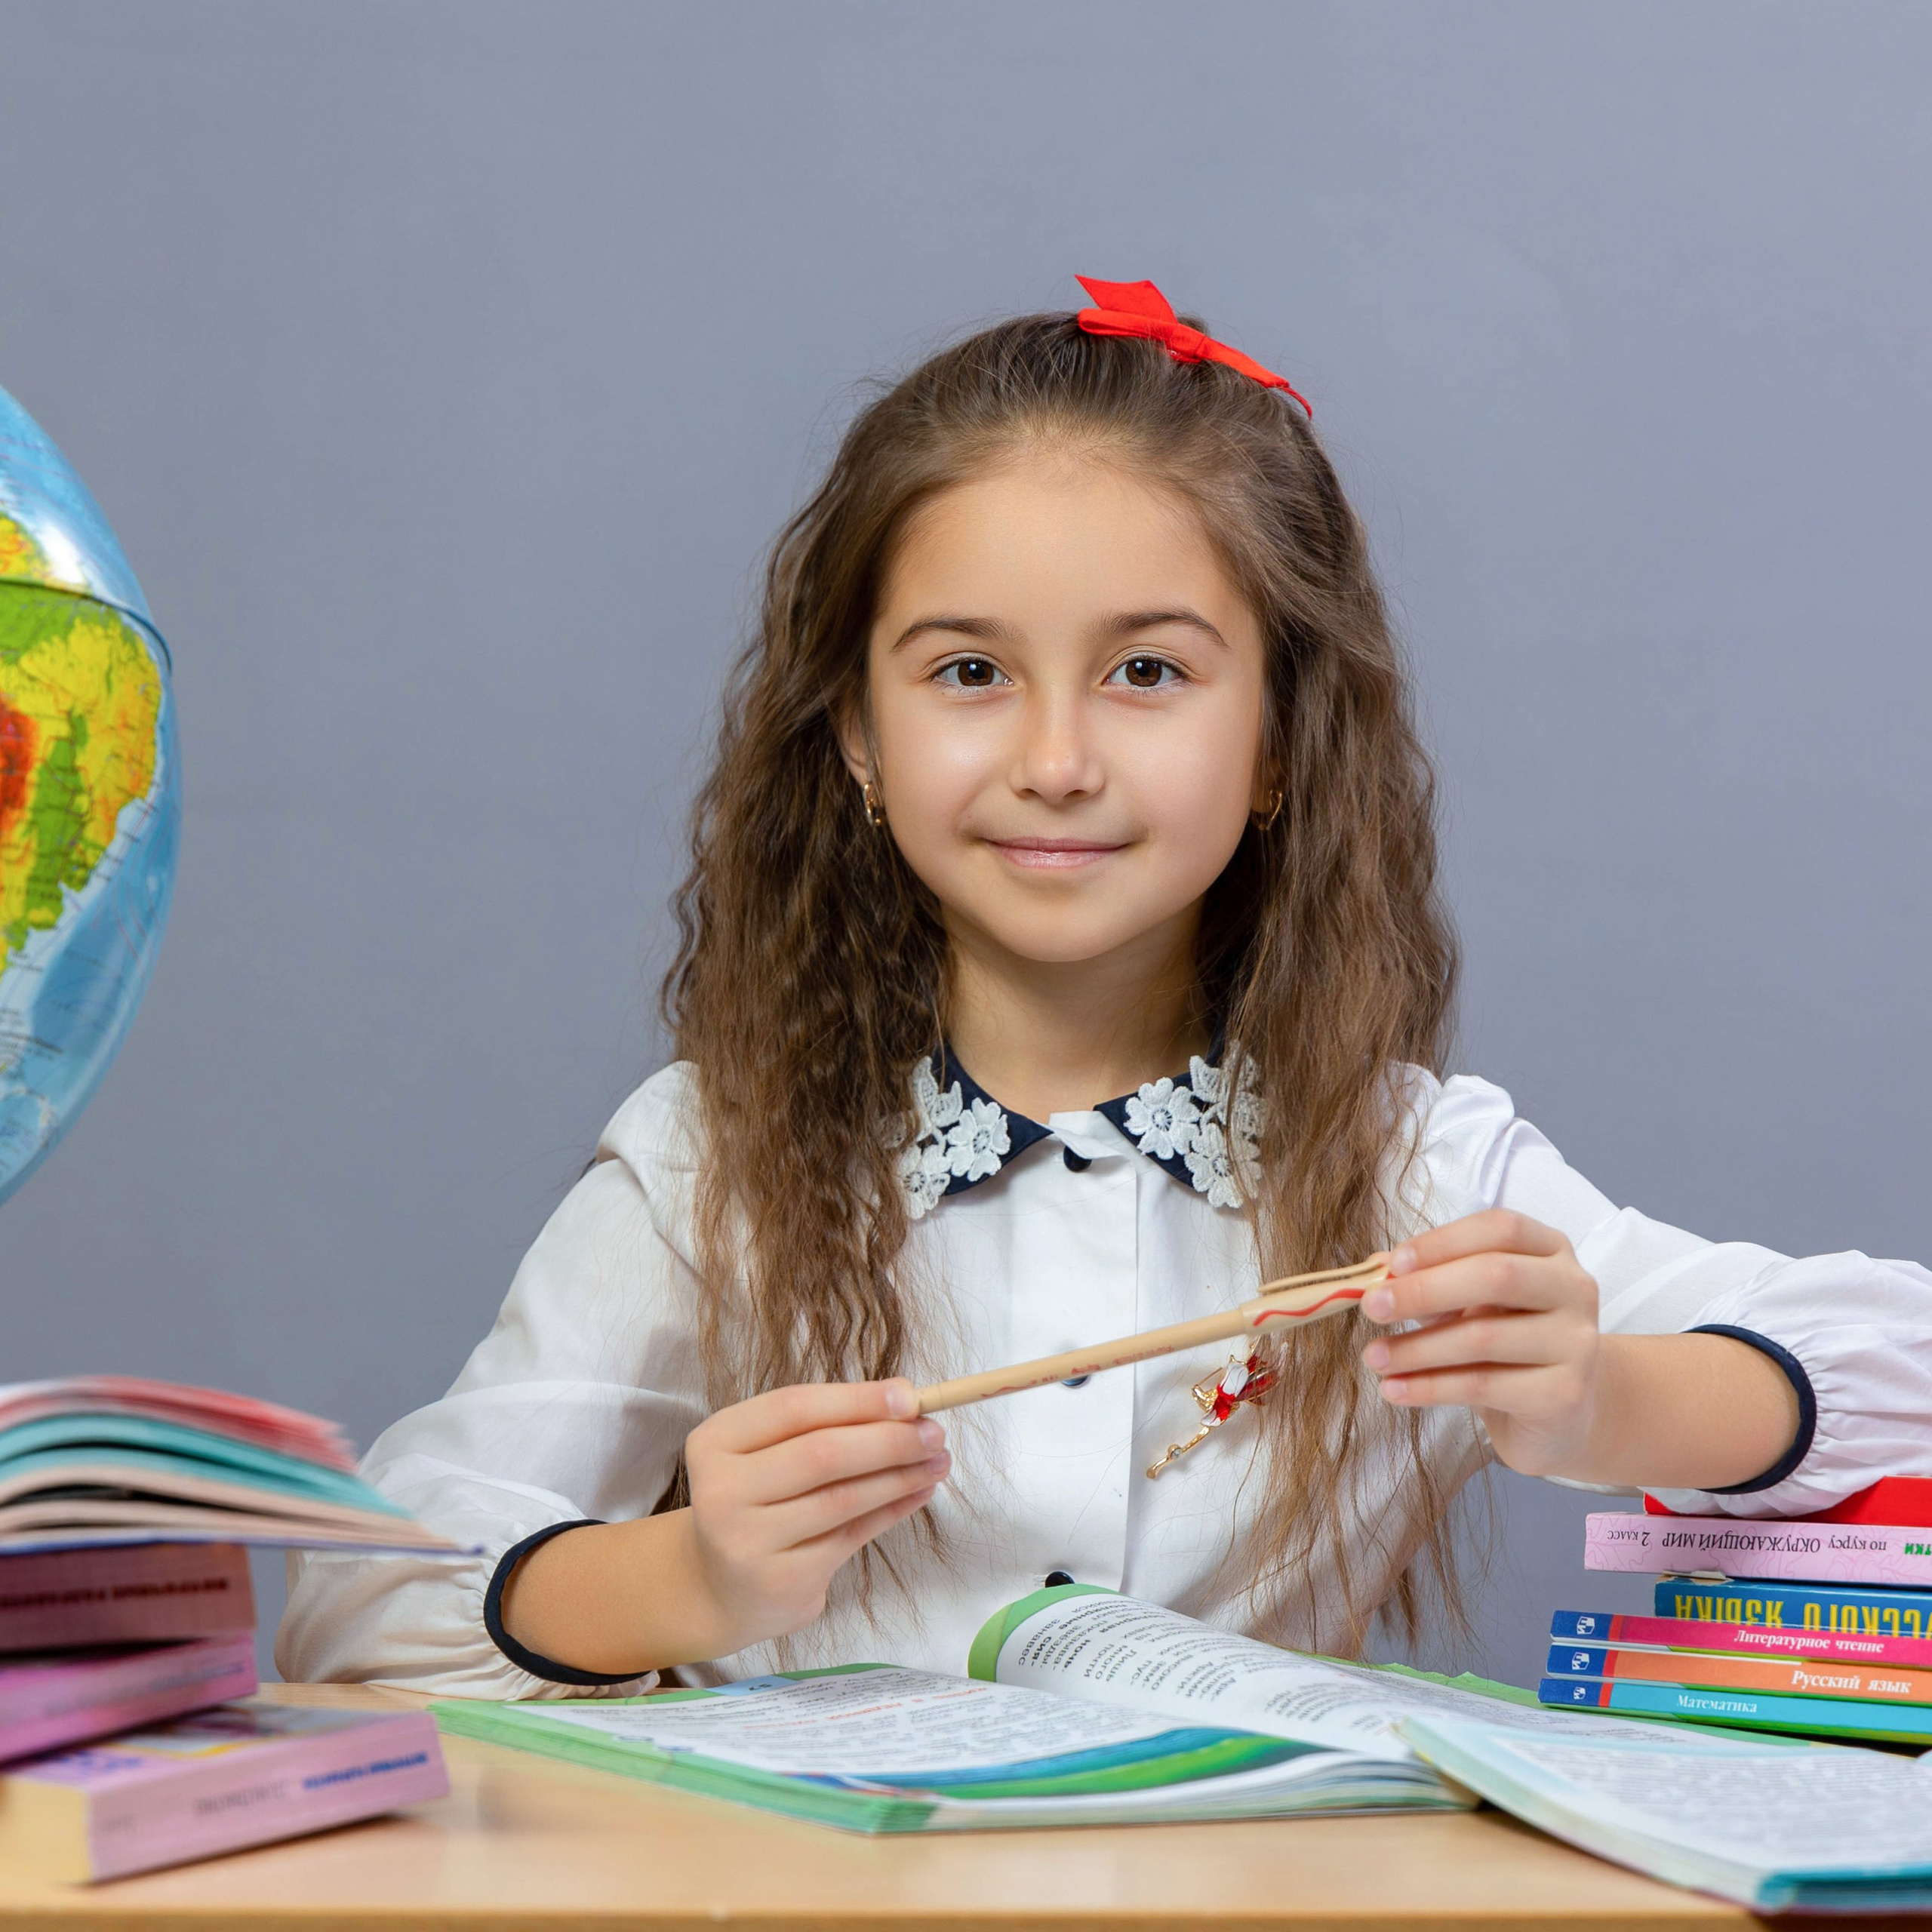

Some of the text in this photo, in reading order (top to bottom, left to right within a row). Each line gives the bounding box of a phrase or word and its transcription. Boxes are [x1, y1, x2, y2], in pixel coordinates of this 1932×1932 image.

[1641, 1532, 1651, 1546] 2
[1663, 1533, 1697, 1548] МИР
[1699, 1530, 1820, 1553] ОКРУЖАЮЩИЙ
[1828, 1535, 1867, 1550] курсу
[1869, 1540, 1887, 1550] по
[1675, 1595, 1932, 1640] ССКОГО ЯЗЫКА
[1018, 1619, 1060, 1666] занавес
[1031, 1636, 1052, 1666] сия-
[1053, 1620, 1108, 1671] показыва-
[1734, 1630, 1885, 1654] Литературное чтение
[1083, 1644, 1115, 1678] почти
[1095, 1645, 1128, 1680] много
[1106, 1650, 1137, 1682] Лишь
[1791, 1670, 1912, 1694] Русский язык
[1676, 1694, 1758, 1713] Математика
